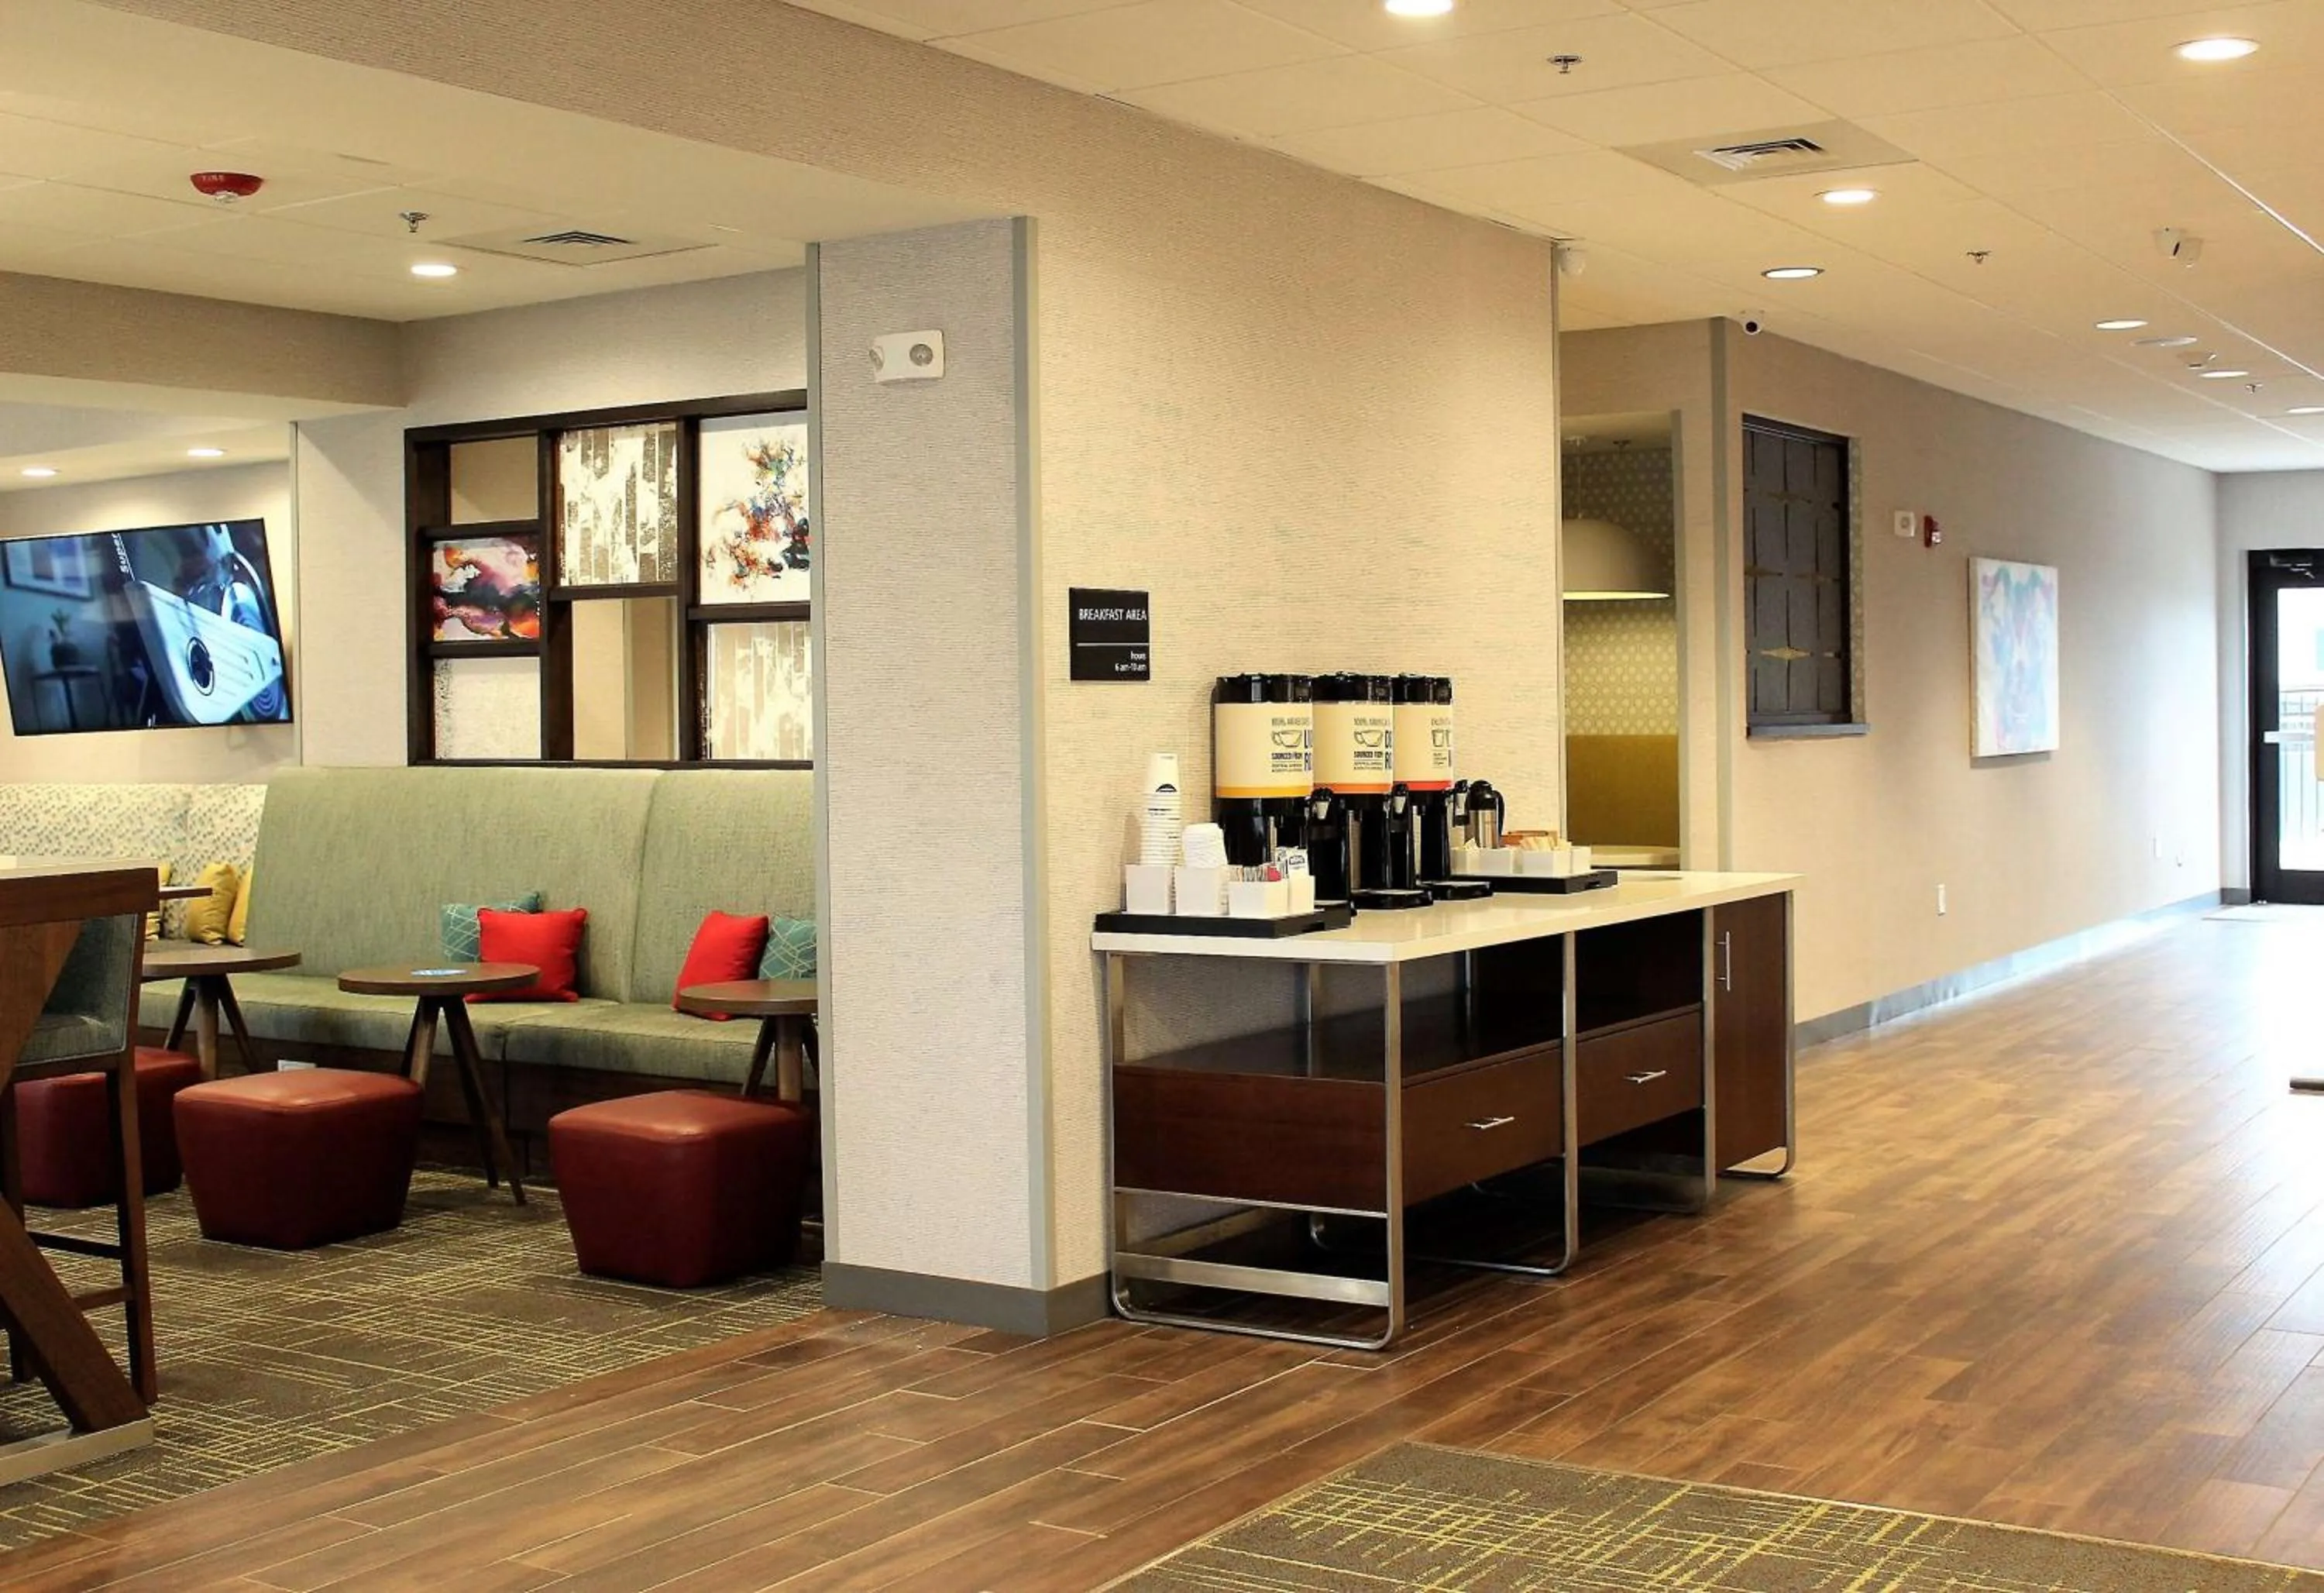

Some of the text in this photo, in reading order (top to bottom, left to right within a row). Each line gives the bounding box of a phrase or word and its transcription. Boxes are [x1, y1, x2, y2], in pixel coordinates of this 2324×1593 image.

[1078, 608, 1147, 621] BREAKFAST AREA
[1130, 650, 1147, 661] hours
